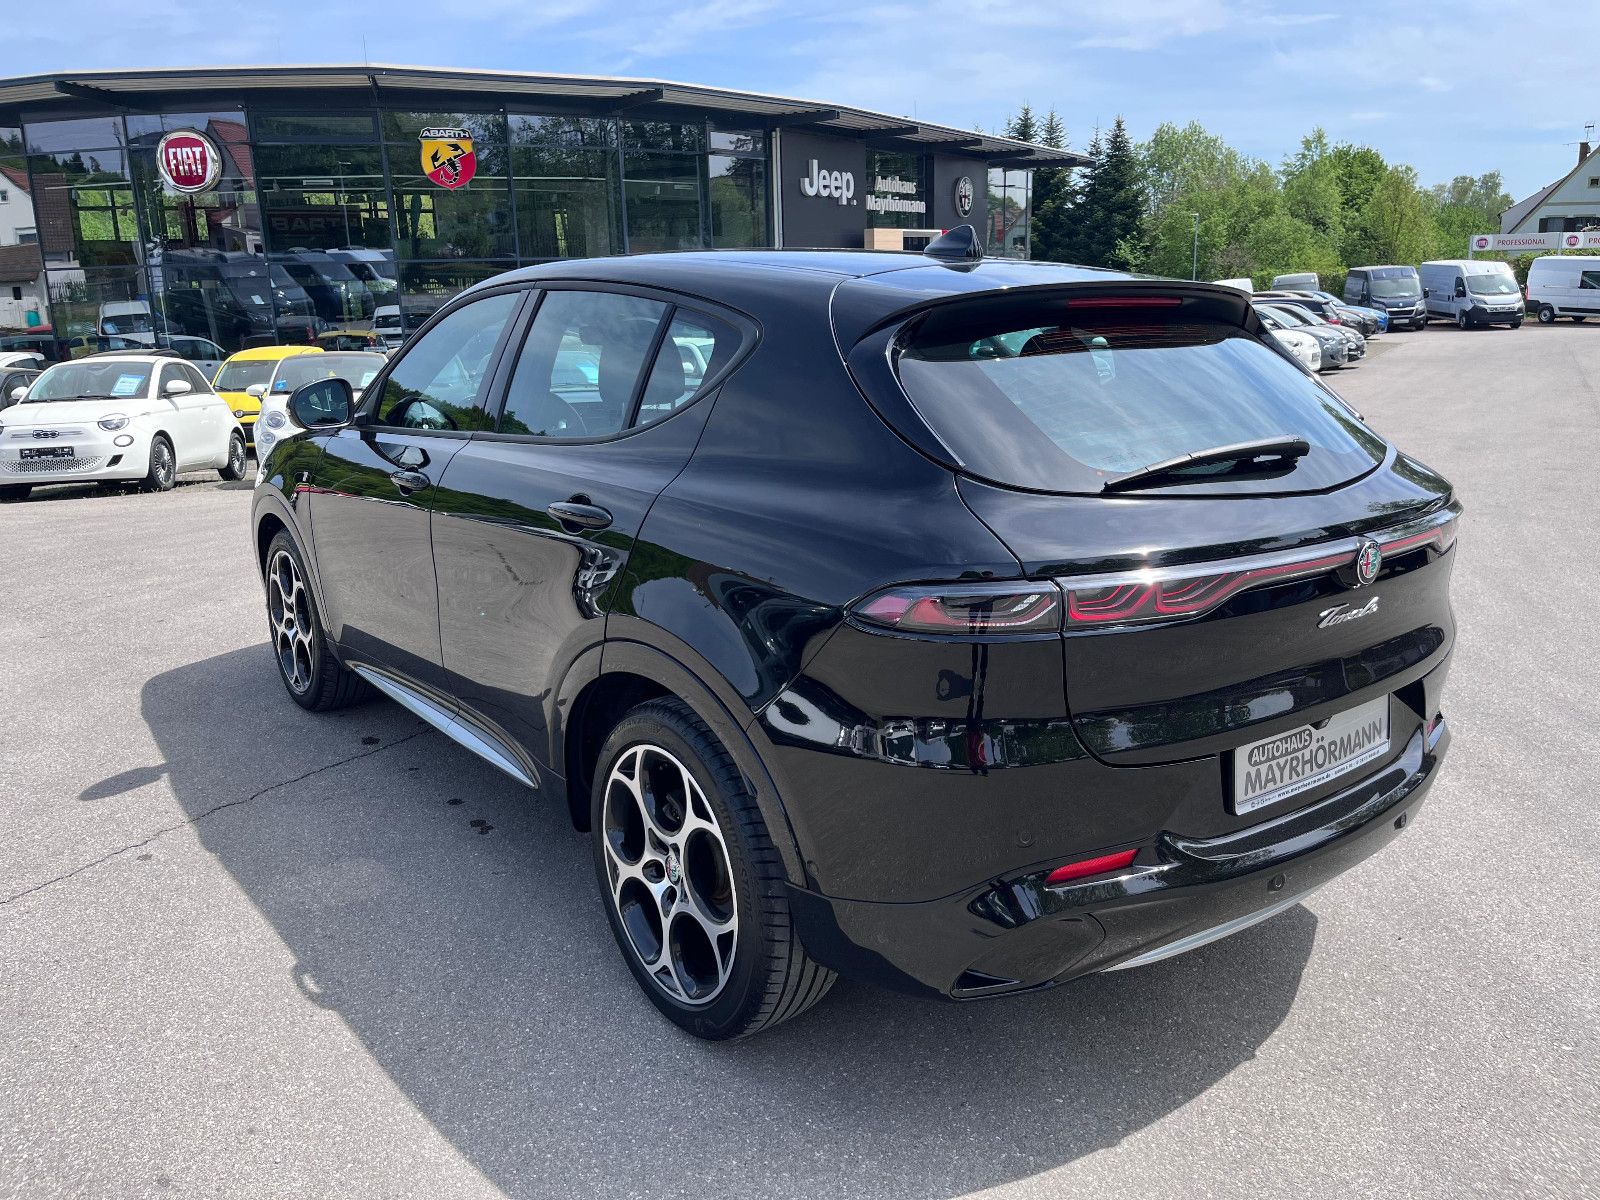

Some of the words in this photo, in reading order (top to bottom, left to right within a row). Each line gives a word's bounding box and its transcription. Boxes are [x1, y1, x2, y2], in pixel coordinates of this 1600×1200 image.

[421, 129, 470, 138] ABARTH
[168, 146, 203, 177] FIAT
[800, 159, 854, 205] Jeep
[874, 175, 917, 195] Autohaus
[865, 194, 926, 215] Mayrhörmann
[1497, 238, 1545, 246] PROFESSIONAL
[1243, 717, 1383, 797] MAYRHÖRMANN
[1250, 730, 1312, 765] AUTOHAUS
